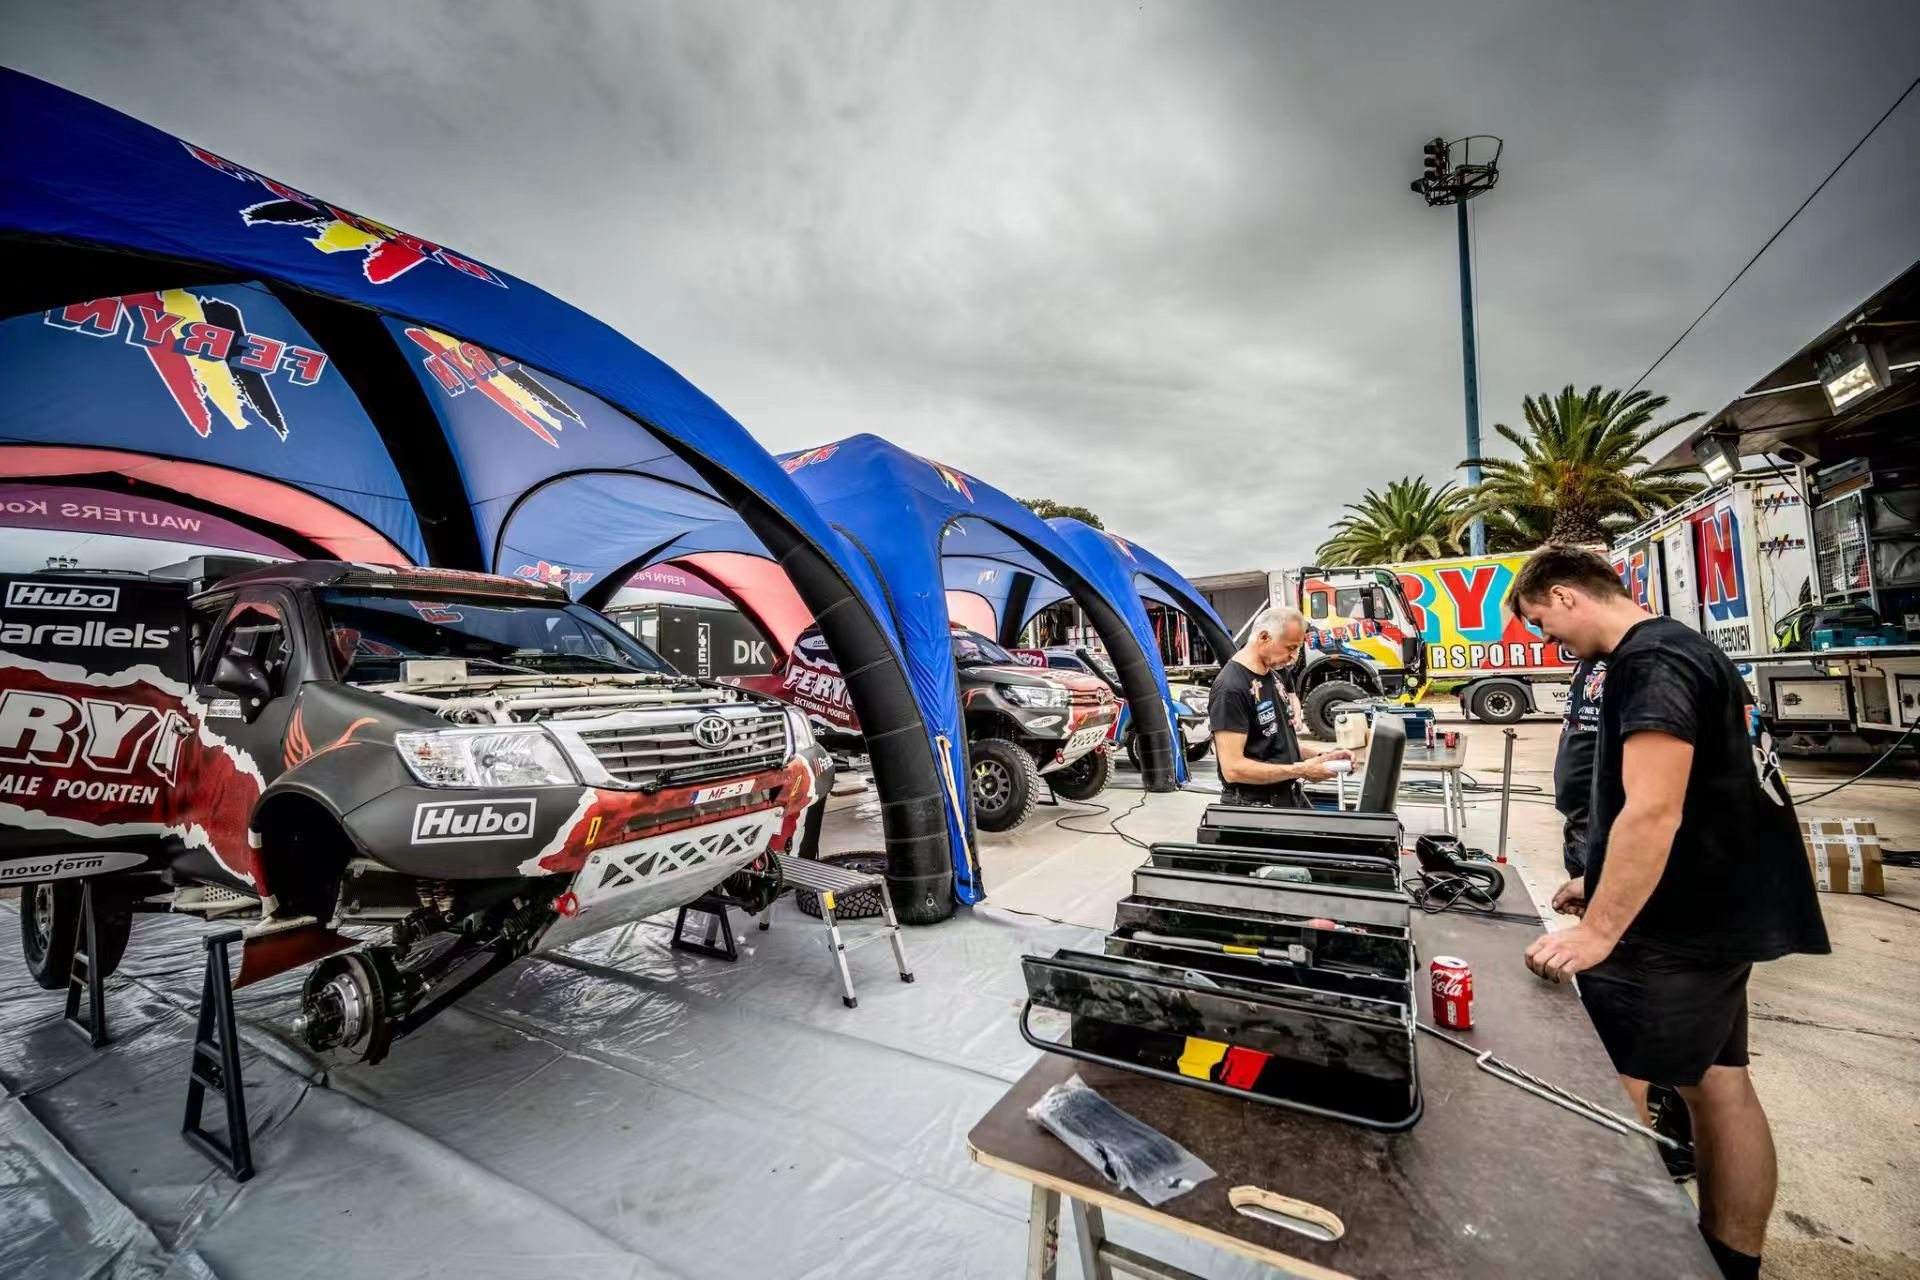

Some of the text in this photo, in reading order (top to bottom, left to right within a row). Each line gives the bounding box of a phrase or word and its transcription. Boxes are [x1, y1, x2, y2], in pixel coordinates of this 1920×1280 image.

[12, 586, 112, 607] Hubo
[0, 620, 171, 649] arallels
[1306, 618, 1379, 651] FERYN
[733, 639, 766, 665] DK
[1427, 642, 1545, 669] RSPORT
[52, 779, 159, 805] POORTEN
[419, 806, 529, 836] Hubo
[1, 858, 104, 877] novoferm
